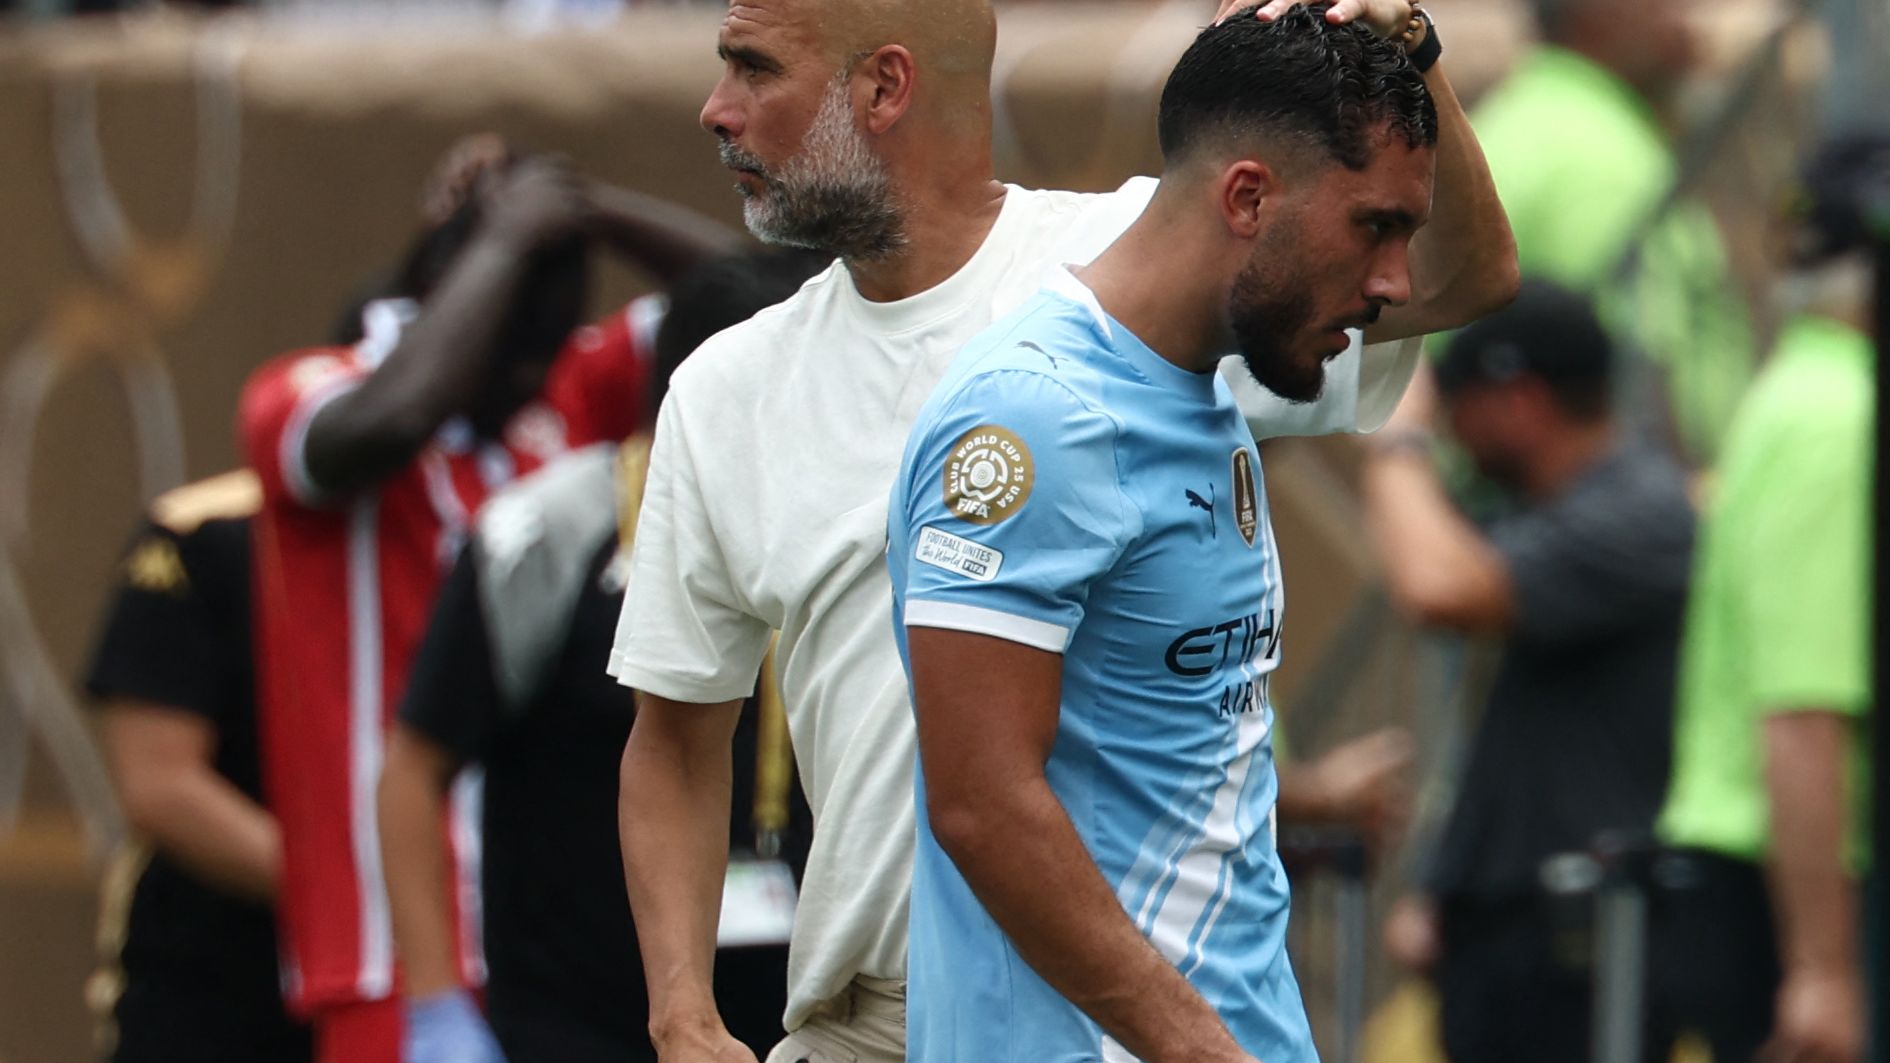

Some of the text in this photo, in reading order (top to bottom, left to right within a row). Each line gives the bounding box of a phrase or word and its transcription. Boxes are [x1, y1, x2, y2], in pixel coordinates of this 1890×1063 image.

[950, 435, 1024, 508] CLUB WORLD CUP 25 USA
[957, 497, 988, 518] FIFA
[962, 543, 992, 562] UNITES
[964, 562, 986, 576] FIFA
